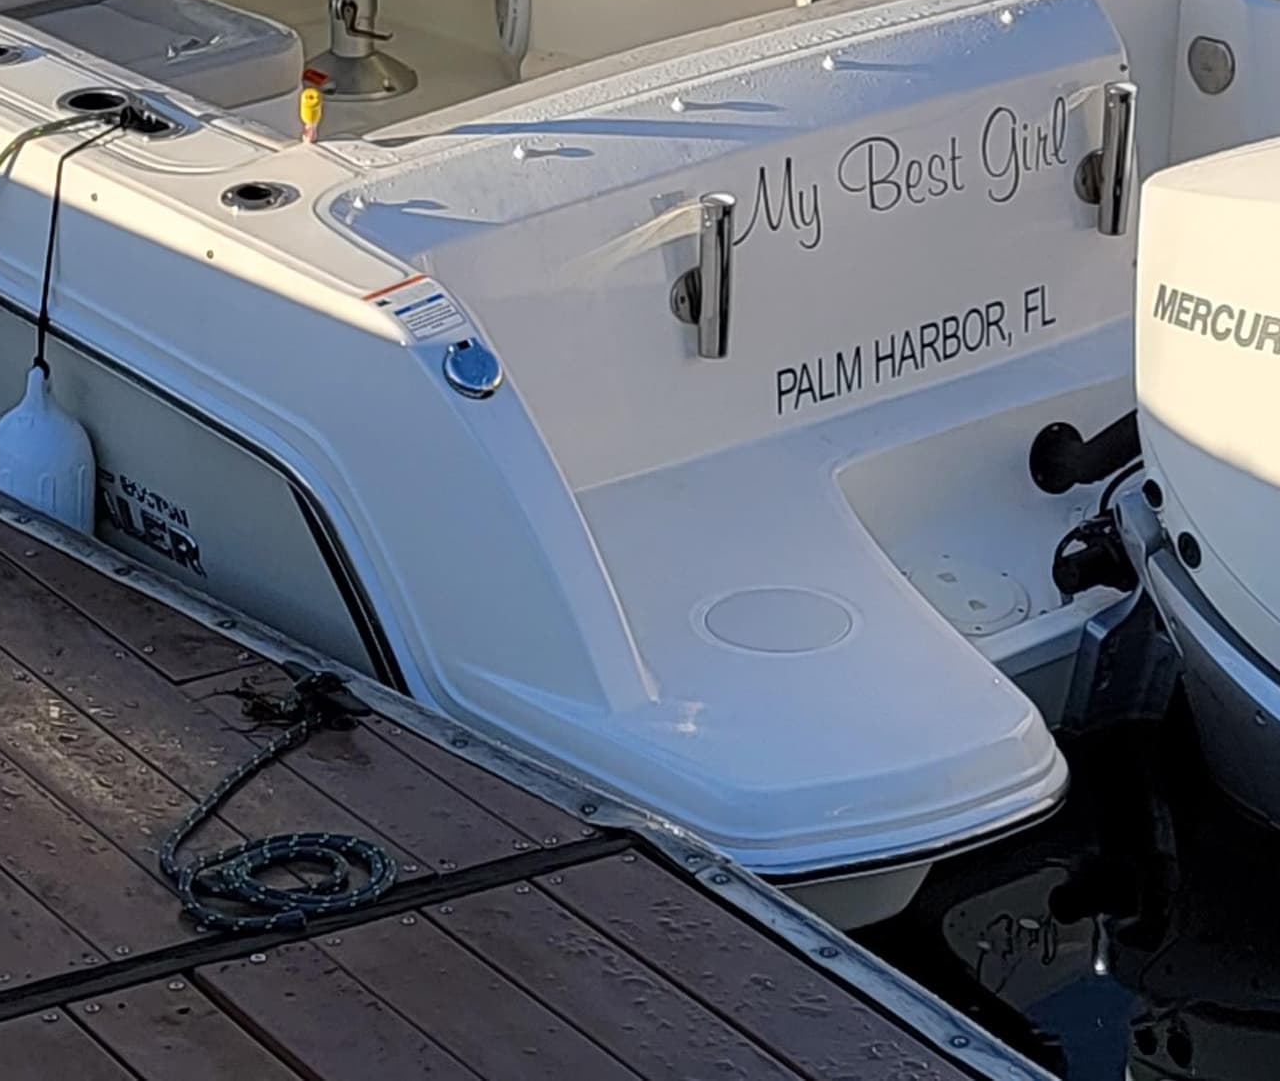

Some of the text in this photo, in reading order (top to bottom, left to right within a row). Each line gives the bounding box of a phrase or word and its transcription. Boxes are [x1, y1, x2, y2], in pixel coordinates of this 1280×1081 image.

[733, 96, 1067, 249] My Best Girl
[776, 285, 1057, 415] PALM HARBOR, FL
